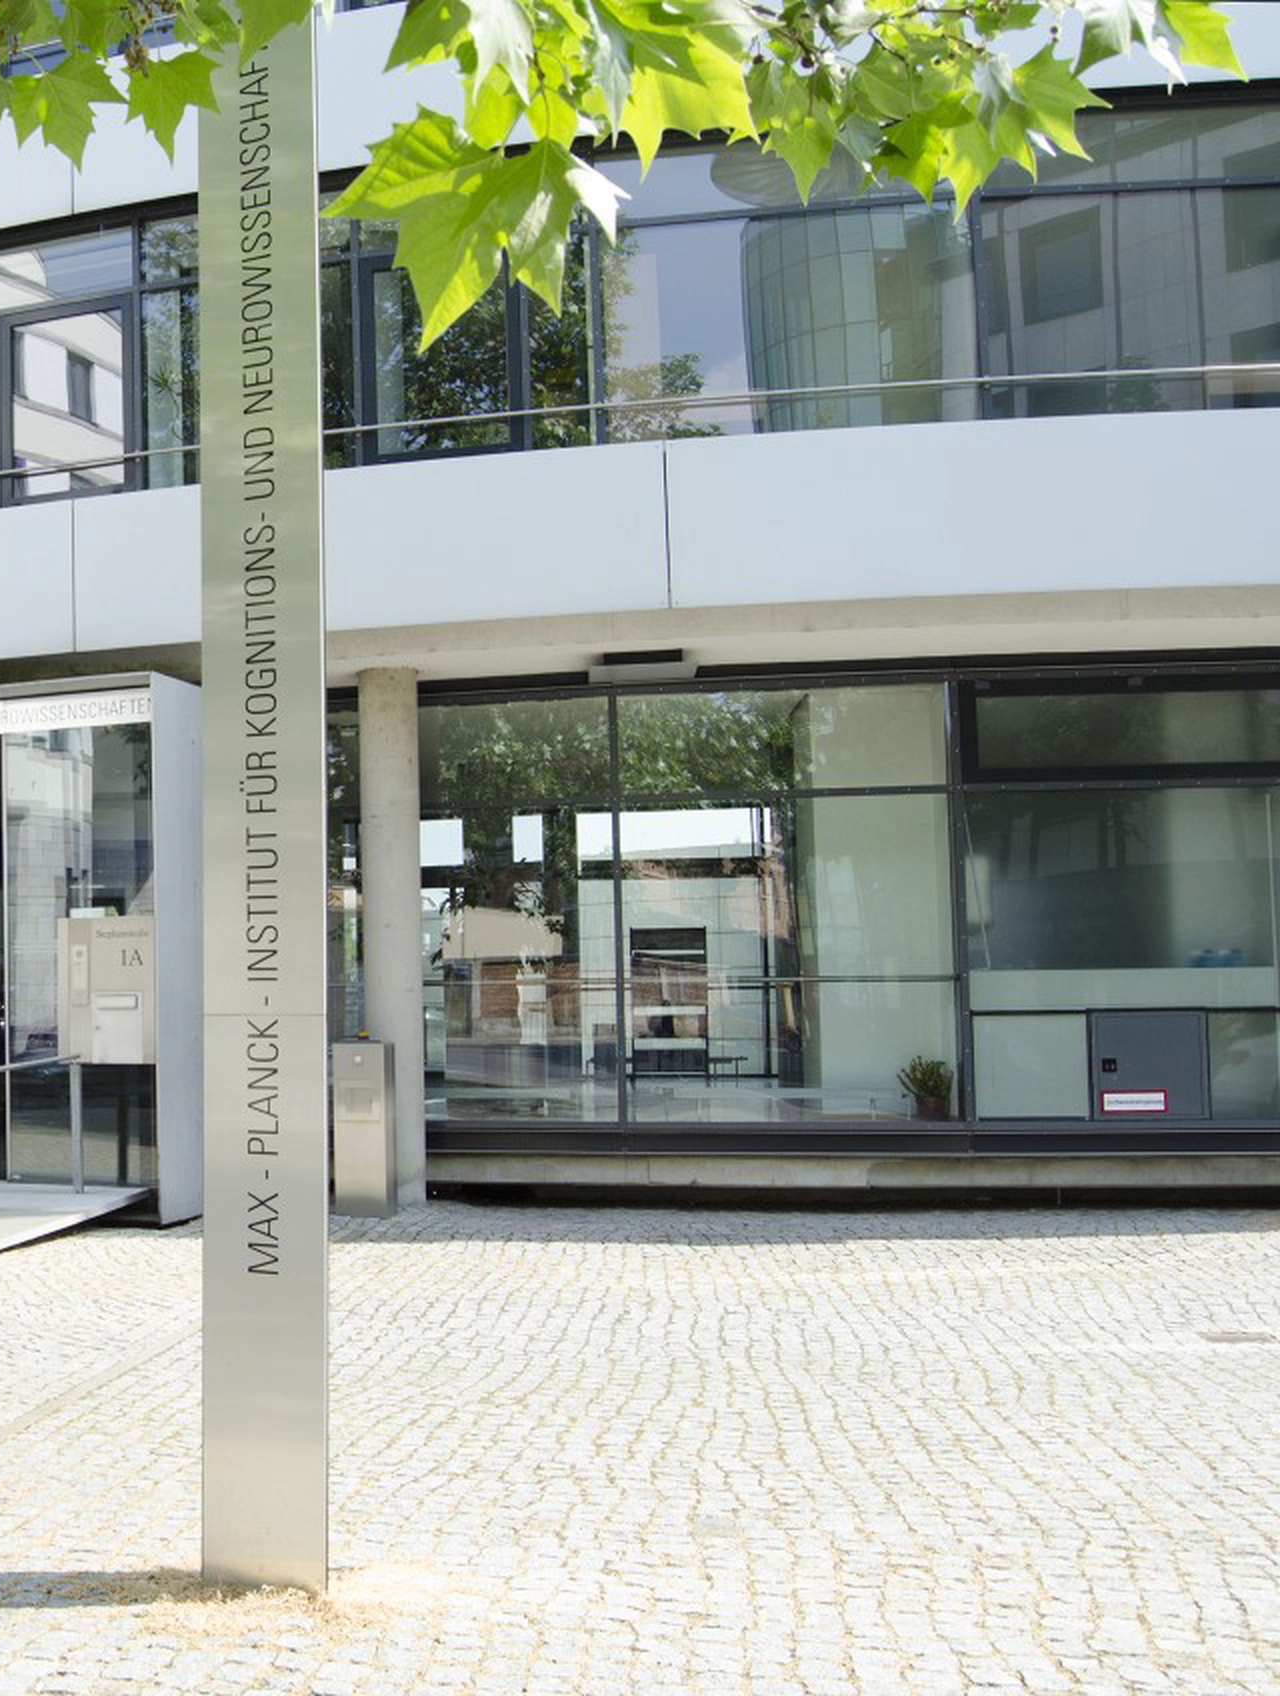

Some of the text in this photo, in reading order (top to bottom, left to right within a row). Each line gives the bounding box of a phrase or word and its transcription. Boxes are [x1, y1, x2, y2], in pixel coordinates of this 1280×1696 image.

[238, 44, 275, 415] NEUROWISSENSCHAF
[243, 426, 276, 502] UND
[243, 512, 278, 737] KOGNITIONS-
[239, 750, 278, 814] FÜR
[245, 827, 280, 982] INSTITUT
[246, 1018, 280, 1156] PLANCK
[246, 1191, 280, 1276] MAX
